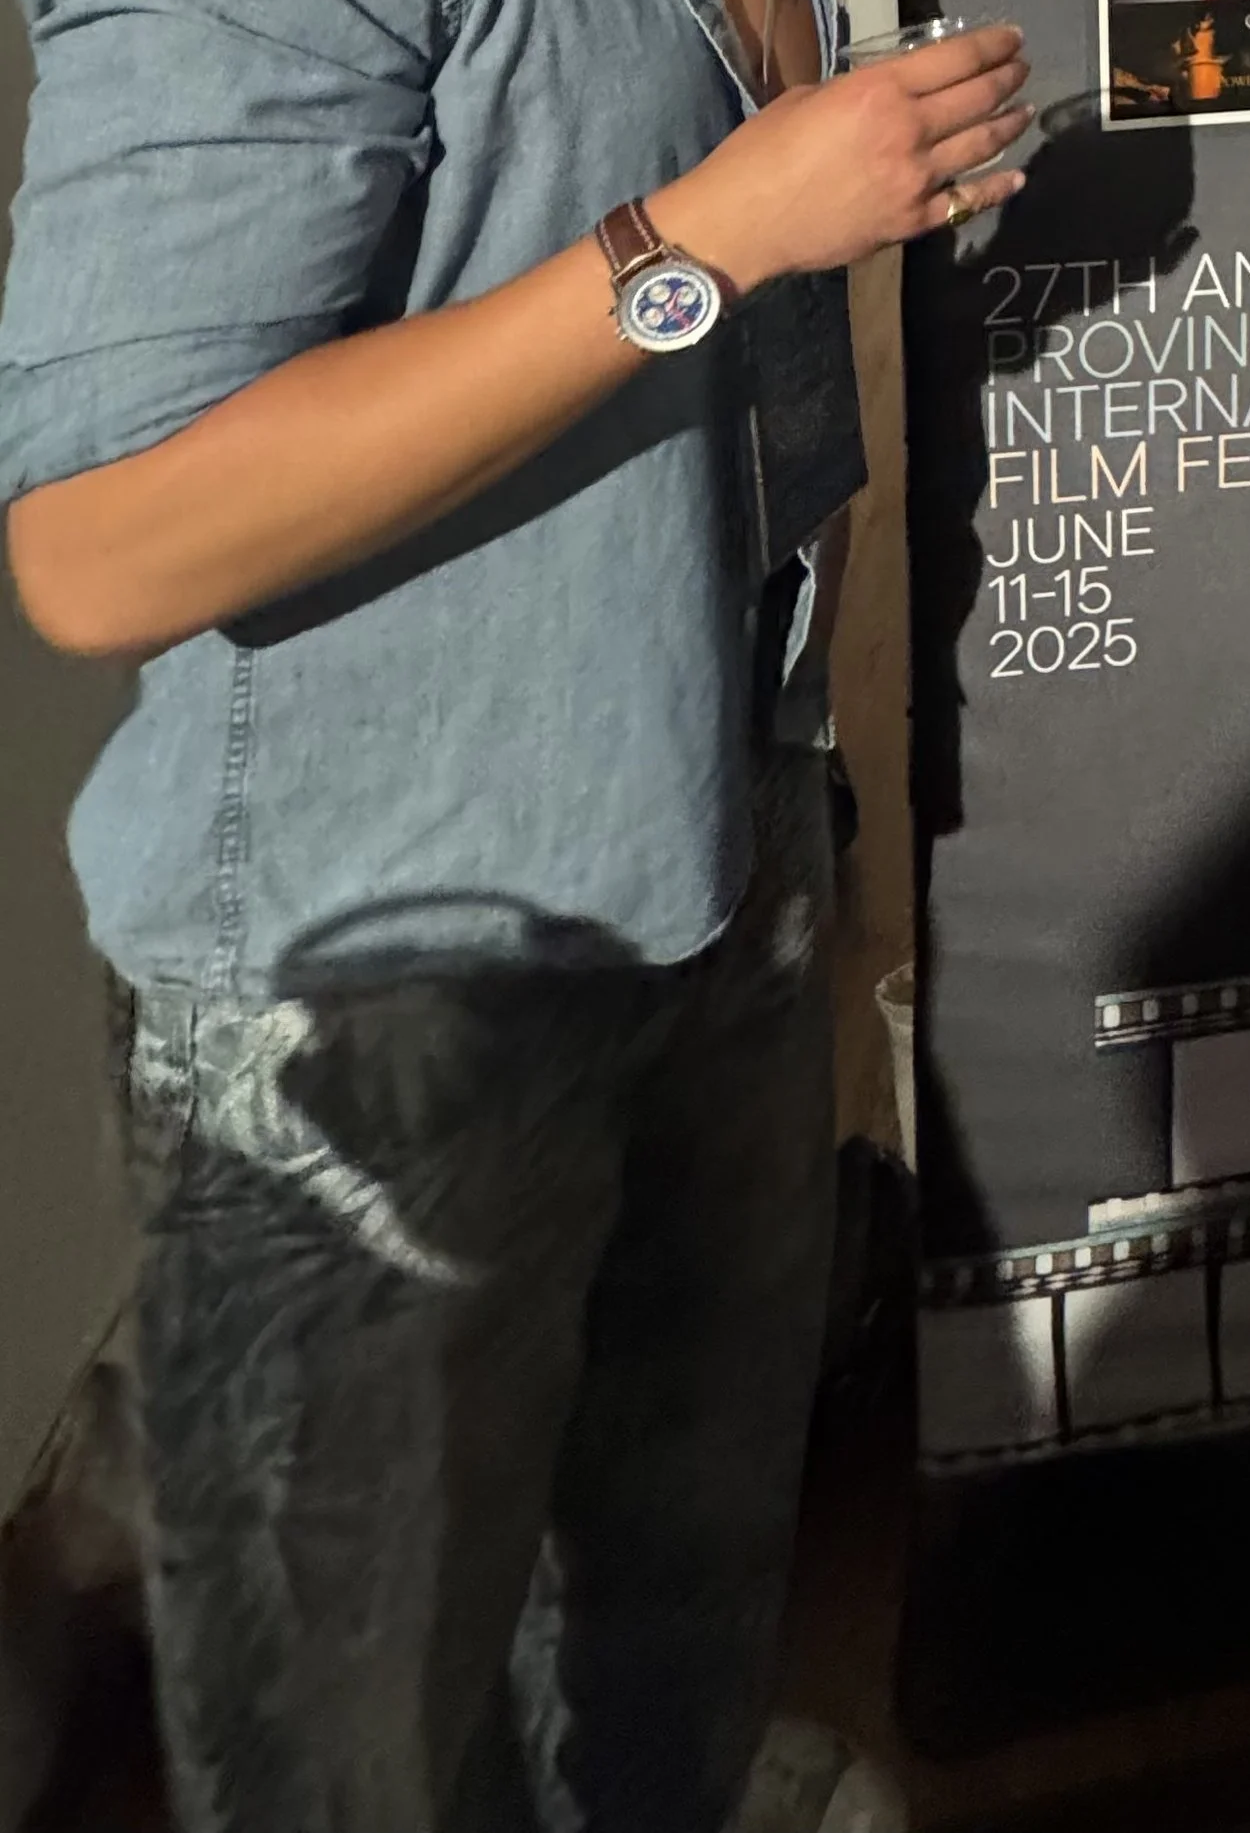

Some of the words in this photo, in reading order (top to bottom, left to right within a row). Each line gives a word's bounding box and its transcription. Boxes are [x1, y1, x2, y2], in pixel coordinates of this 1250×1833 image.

[982, 256, 1155, 325] 27TH
[989, 441, 1147, 509] FILM
[986, 507, 1155, 568] JUNE
[989, 566, 1112, 622] 11-15
[990, 618, 1138, 678] 2025
